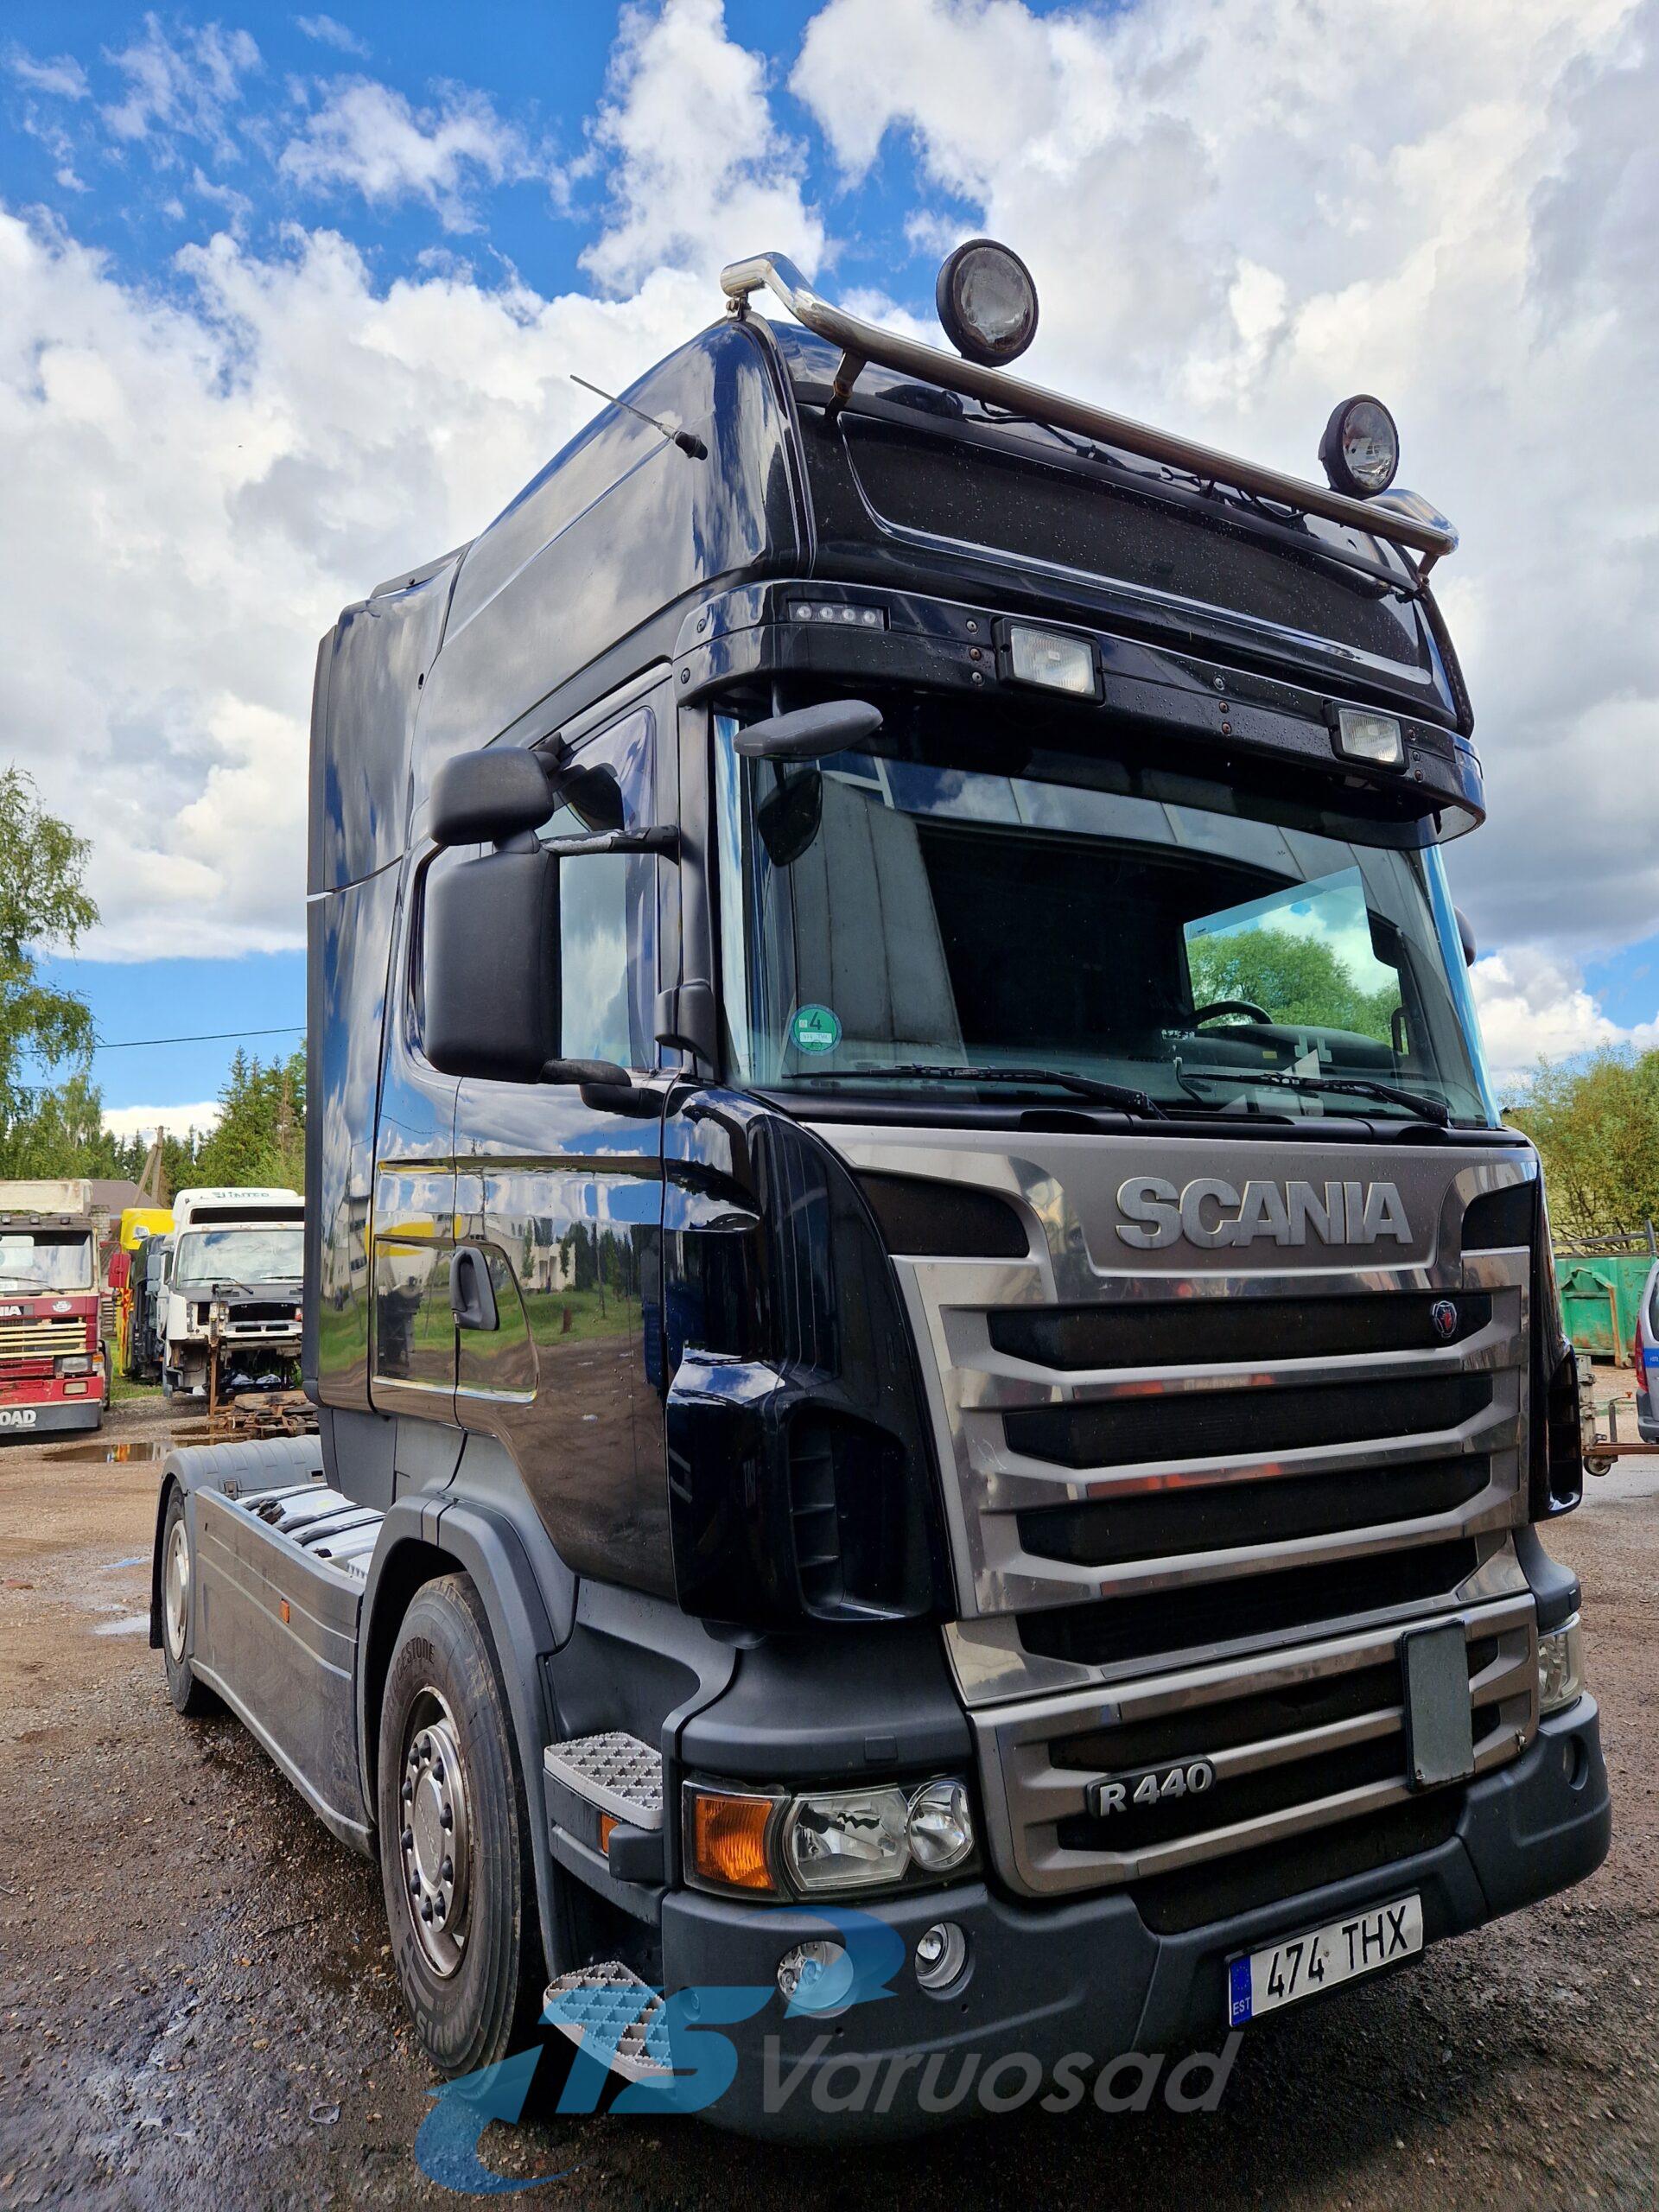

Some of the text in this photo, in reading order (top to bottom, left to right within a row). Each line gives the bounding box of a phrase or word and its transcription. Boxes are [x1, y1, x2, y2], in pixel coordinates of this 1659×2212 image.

[809, 1011, 823, 1031] 4
[1116, 1176, 1414, 1249] SCANIA
[1100, 1762, 1211, 1815] R 440
[1266, 1905, 1408, 1999] 474 THX
[1233, 1998, 1252, 2016] EST
